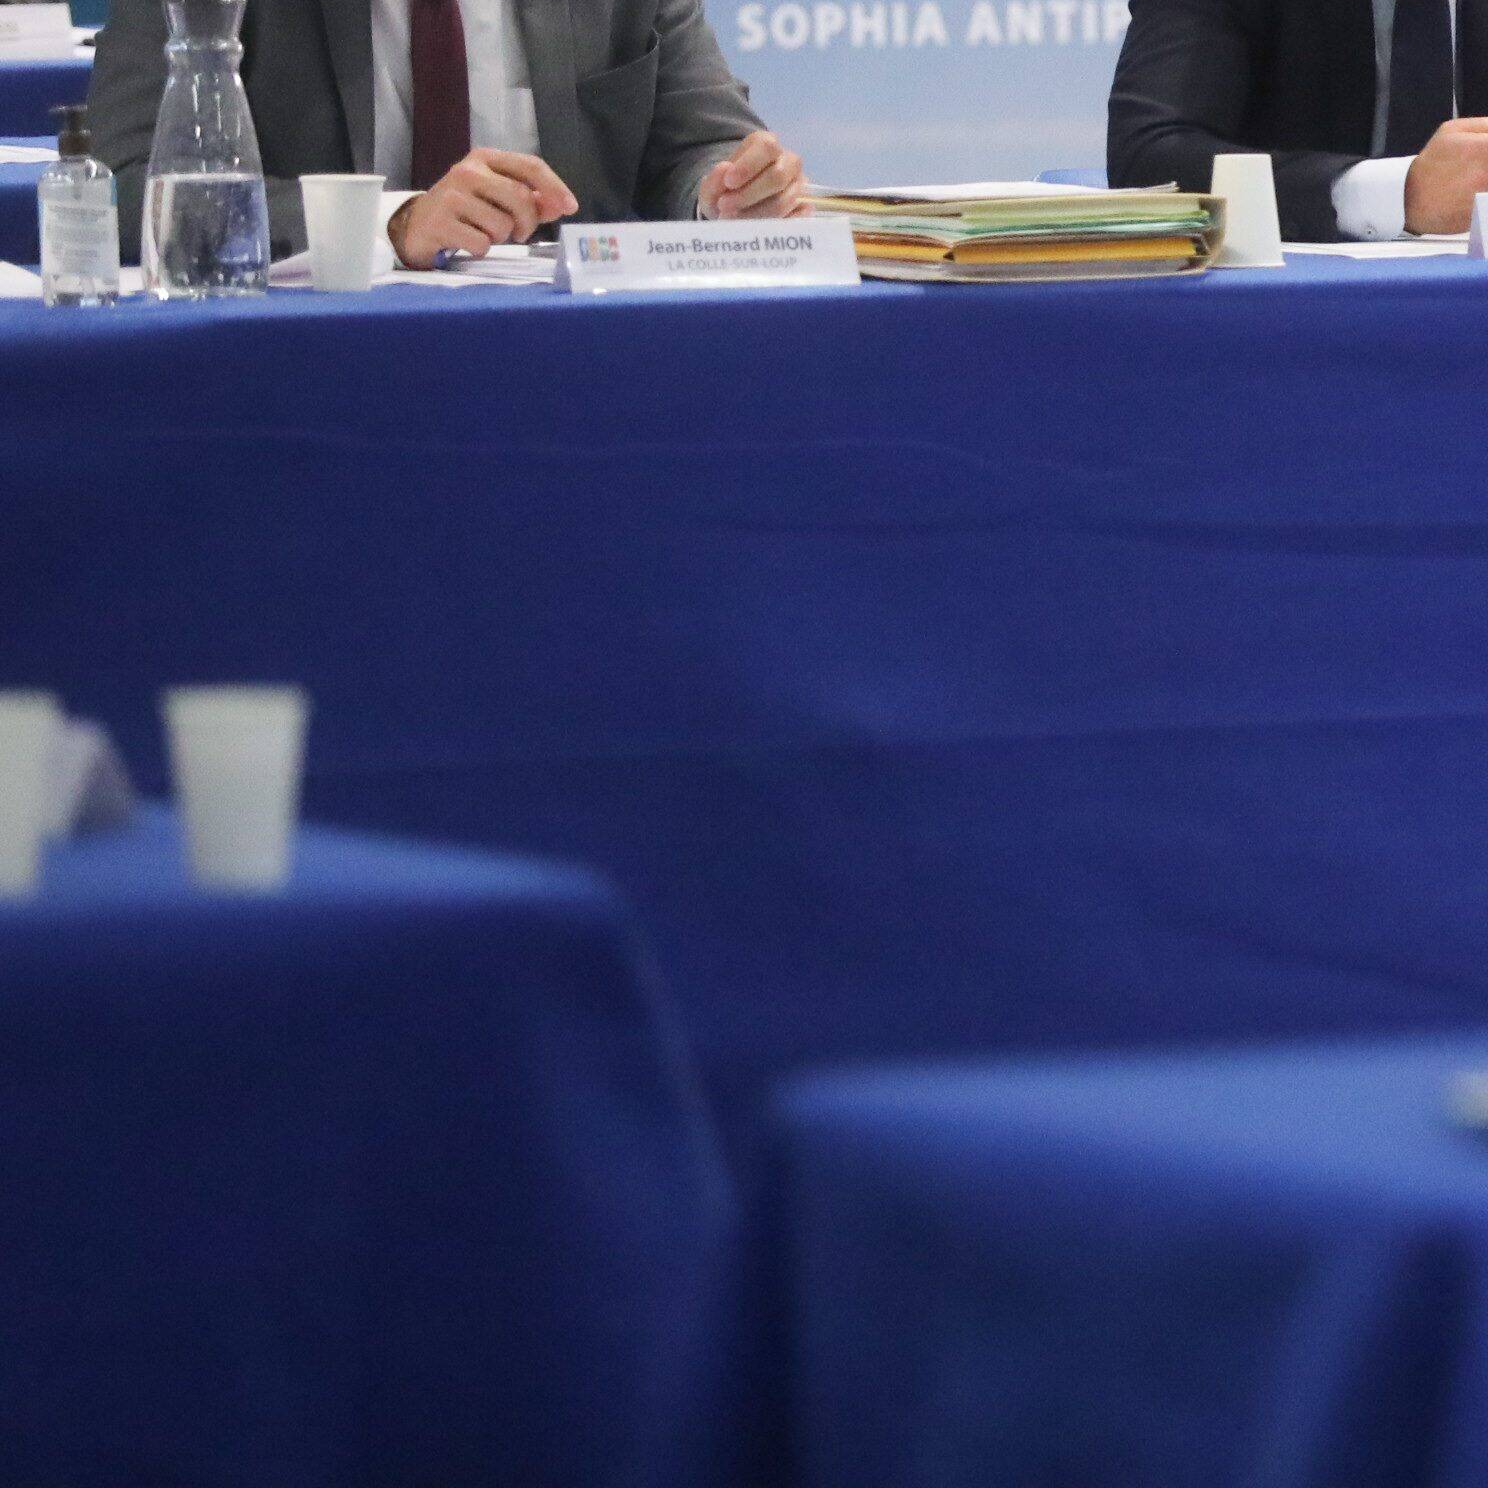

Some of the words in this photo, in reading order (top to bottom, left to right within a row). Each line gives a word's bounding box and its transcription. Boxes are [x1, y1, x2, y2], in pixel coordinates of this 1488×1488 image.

[737, 0, 949, 52] SOPHIA
[646, 237, 762, 255] Jean-Bernard
[763, 235, 814, 252] MION
